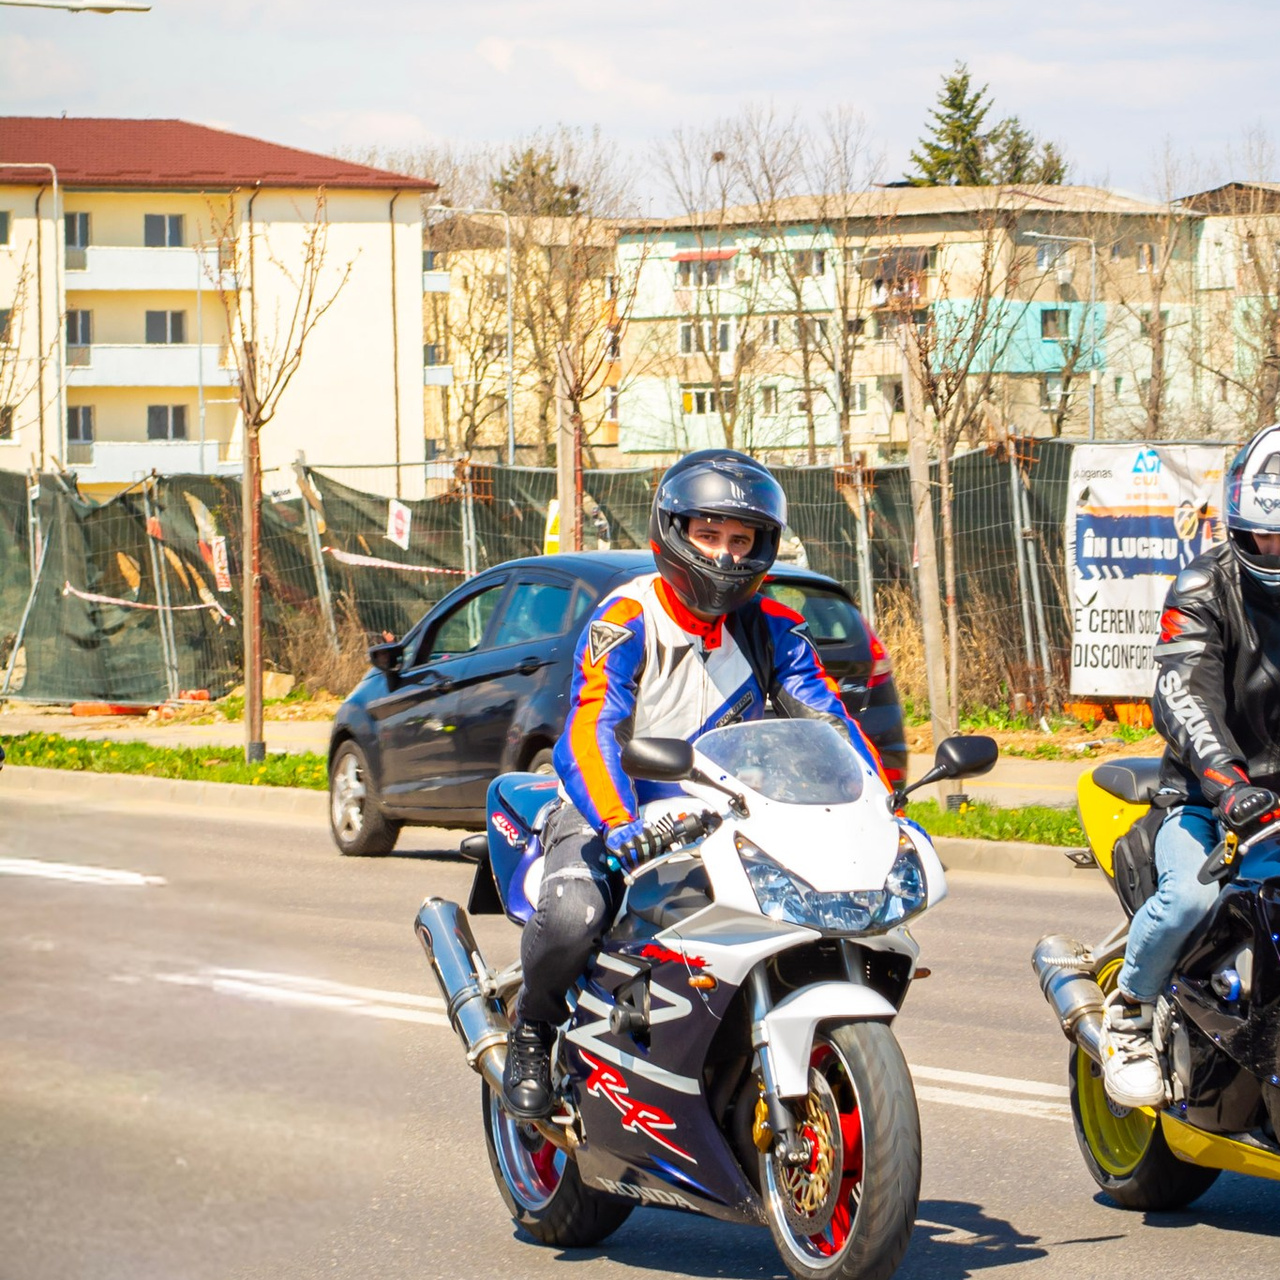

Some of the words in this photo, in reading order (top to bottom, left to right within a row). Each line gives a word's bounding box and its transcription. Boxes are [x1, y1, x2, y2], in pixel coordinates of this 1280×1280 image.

[1082, 528, 1107, 558] ÎN
[1111, 537, 1178, 560] LUCRU
[1074, 608, 1082, 632] E
[1089, 609, 1135, 634] CEREM
[1138, 610, 1161, 634] SCUZ
[1159, 670, 1221, 759] SUZUKI
[595, 1176, 700, 1211] HONDA
